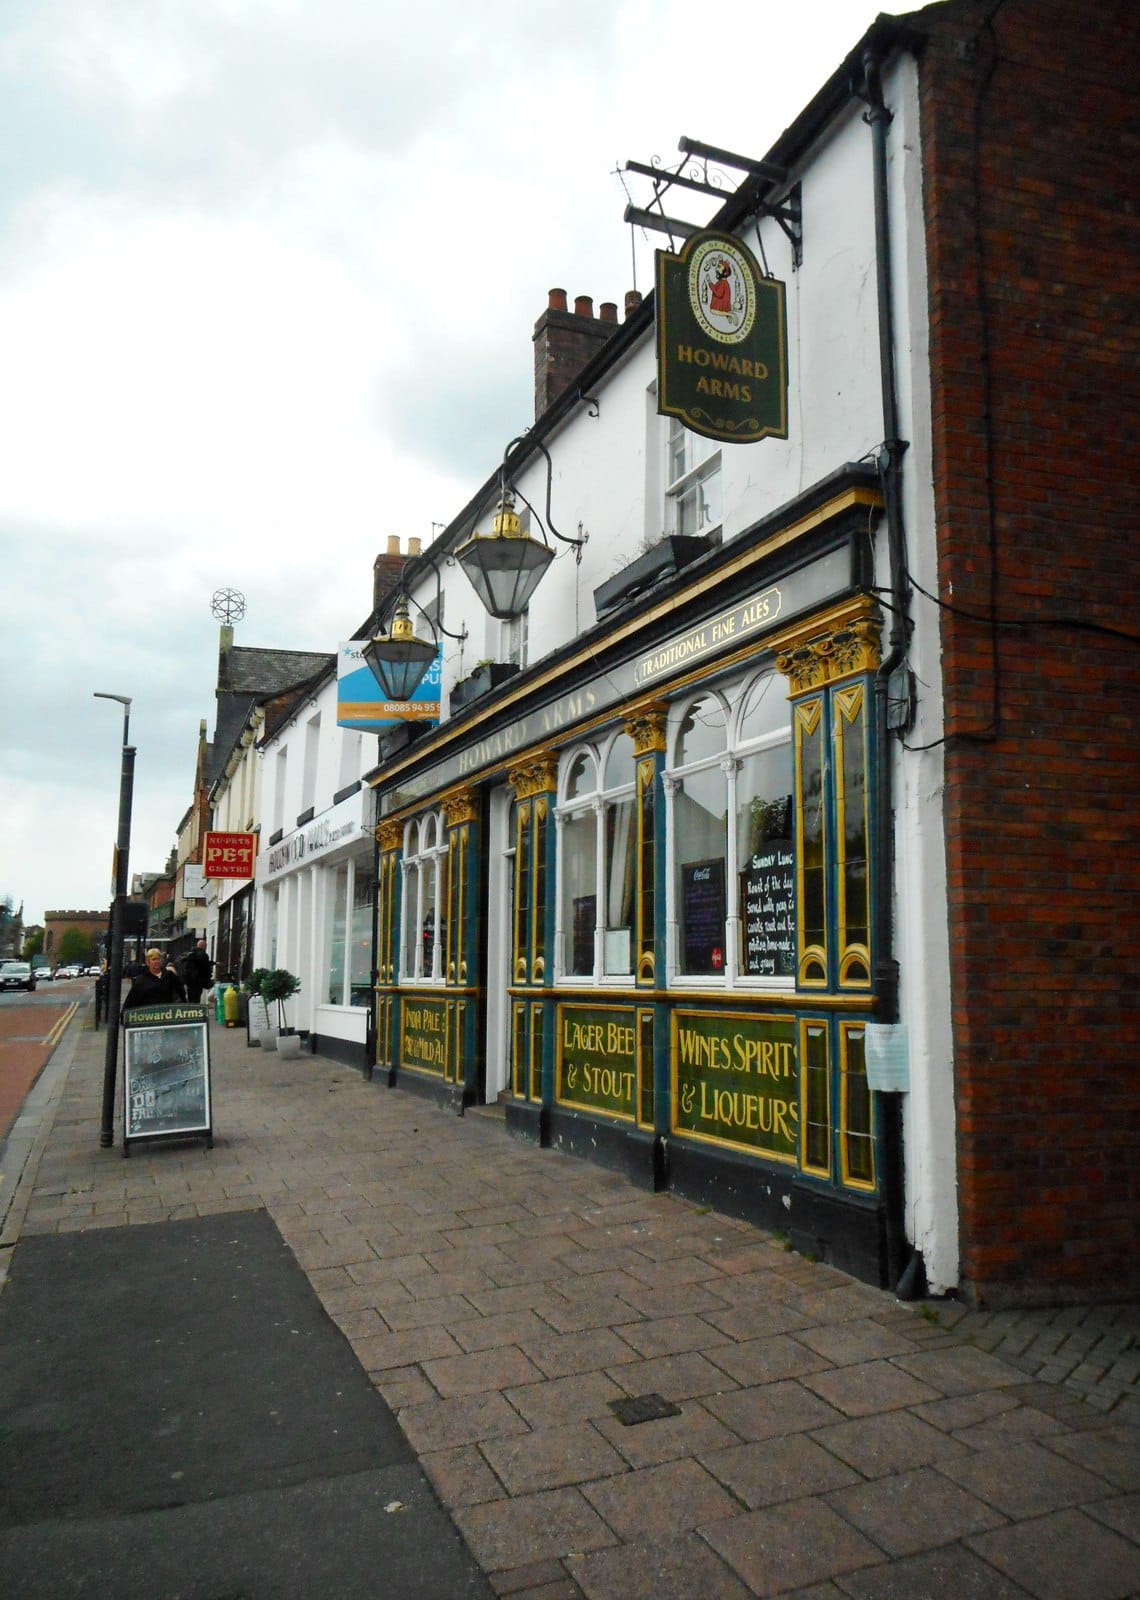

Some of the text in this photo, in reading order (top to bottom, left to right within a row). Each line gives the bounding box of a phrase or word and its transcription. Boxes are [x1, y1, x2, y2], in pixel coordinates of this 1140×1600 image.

[677, 344, 769, 380] HOWARD
[695, 375, 752, 403] ARMS
[641, 598, 769, 677] TRADITIONAL FINE ALES
[383, 703, 410, 712] 08085
[411, 703, 422, 712] 94
[424, 703, 435, 712] 95
[458, 690, 595, 775] HOWARD ARMS
[207, 847, 252, 863] PET
[208, 865, 249, 873] CENTRE
[763, 875, 770, 898] of
[771, 875, 781, 891] the
[763, 897, 775, 912] with
[128, 1008, 204, 1022] Howard Arms
[423, 1009, 440, 1032] PALE
[563, 1019, 635, 1055] LAGER BEE
[567, 1062, 635, 1101] & STOUT
[681, 1082, 696, 1113] &
